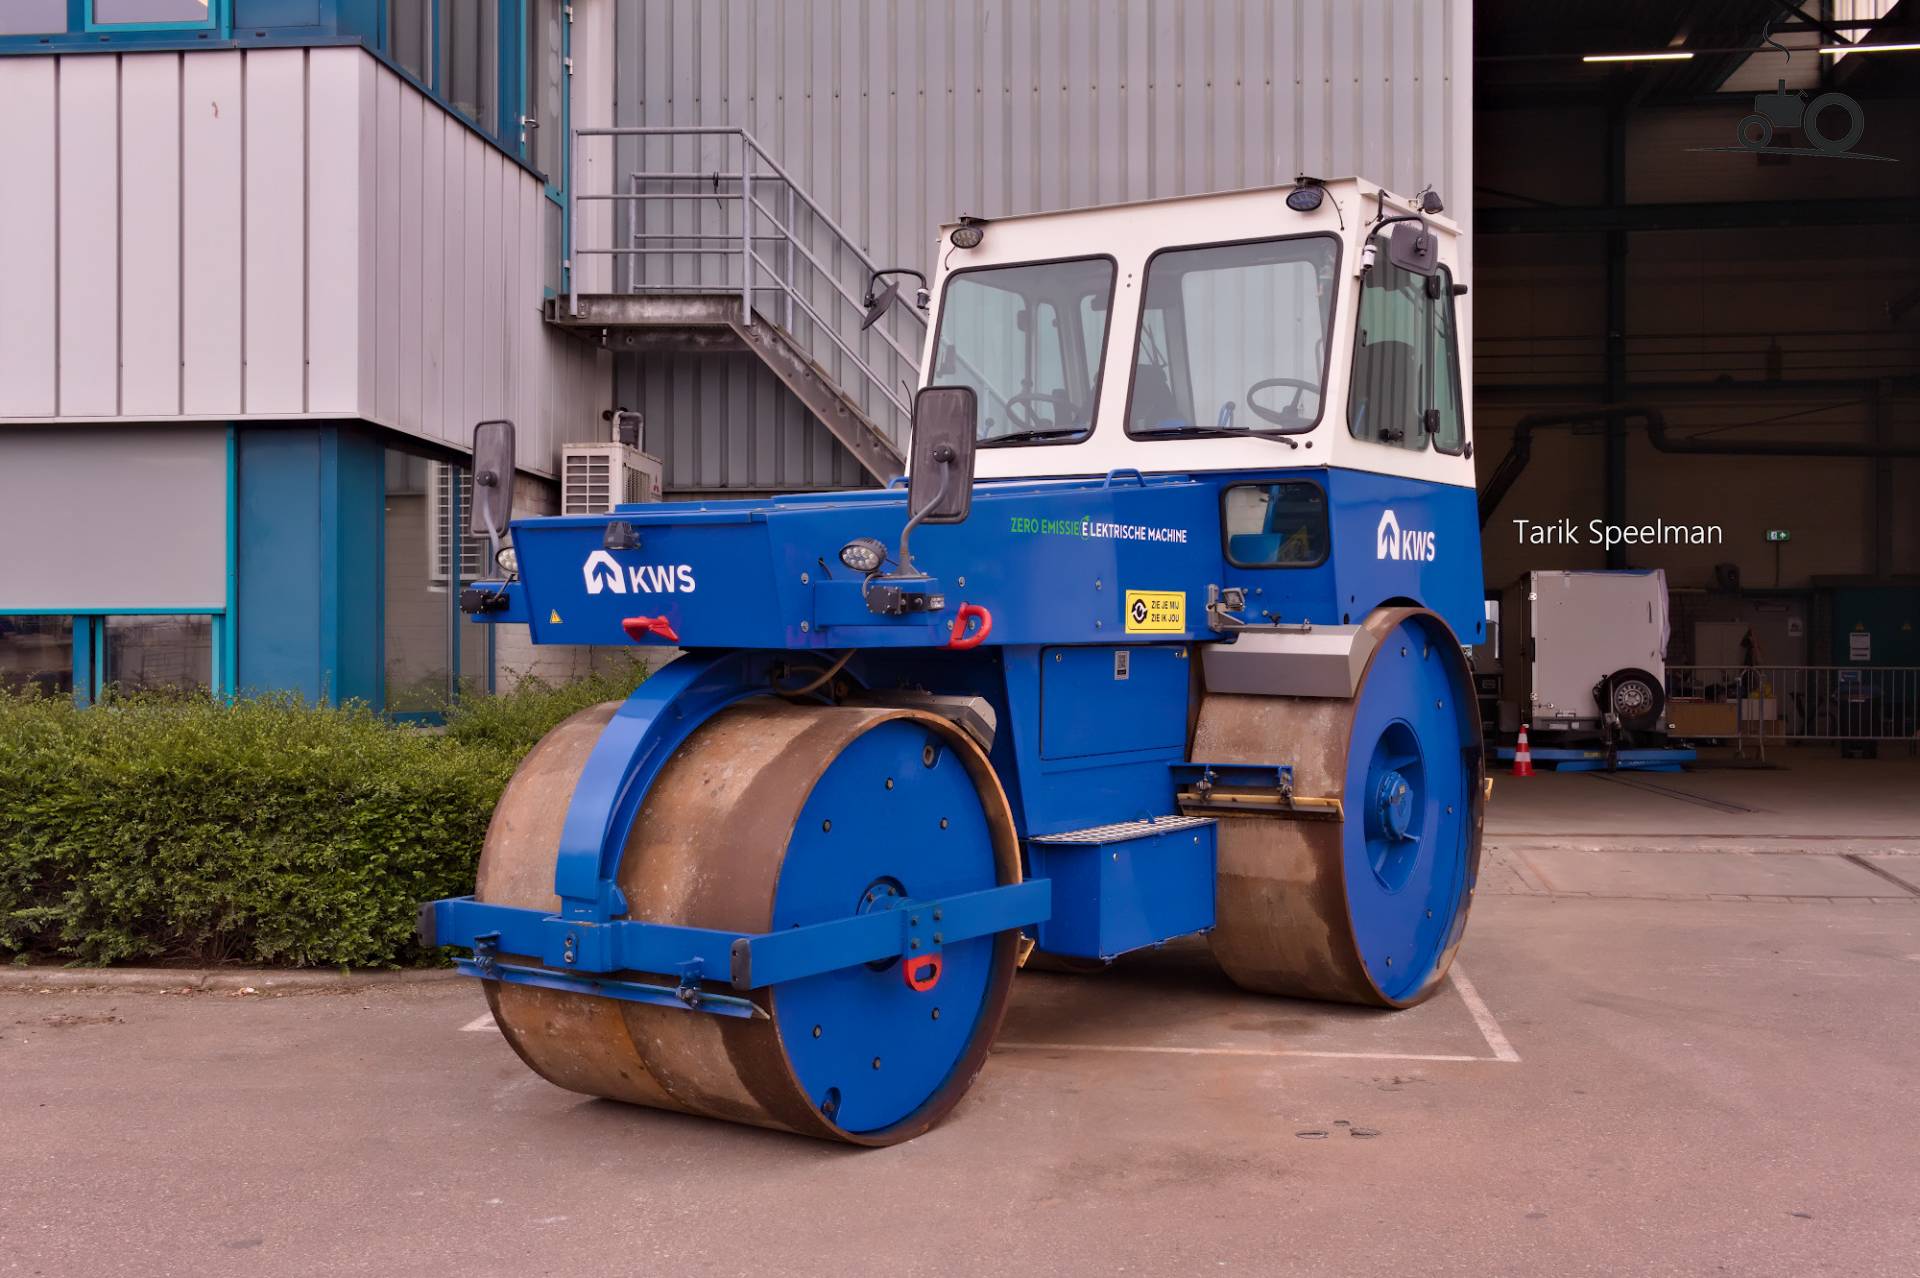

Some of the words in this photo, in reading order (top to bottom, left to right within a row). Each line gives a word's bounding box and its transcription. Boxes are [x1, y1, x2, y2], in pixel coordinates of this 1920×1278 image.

[1010, 517, 1039, 534] ZERO
[1041, 519, 1080, 536] EMISSIE
[1147, 527, 1188, 543] MACHINE
[1402, 530, 1436, 562] KWS
[628, 564, 696, 593] KWS
[1151, 600, 1161, 610] ZIE
[1161, 600, 1169, 610] JE
[1169, 600, 1180, 610] MIJ
[1151, 613, 1161, 623] ZIE
[1161, 613, 1168, 623] IK
[1168, 613, 1180, 623] JOU
